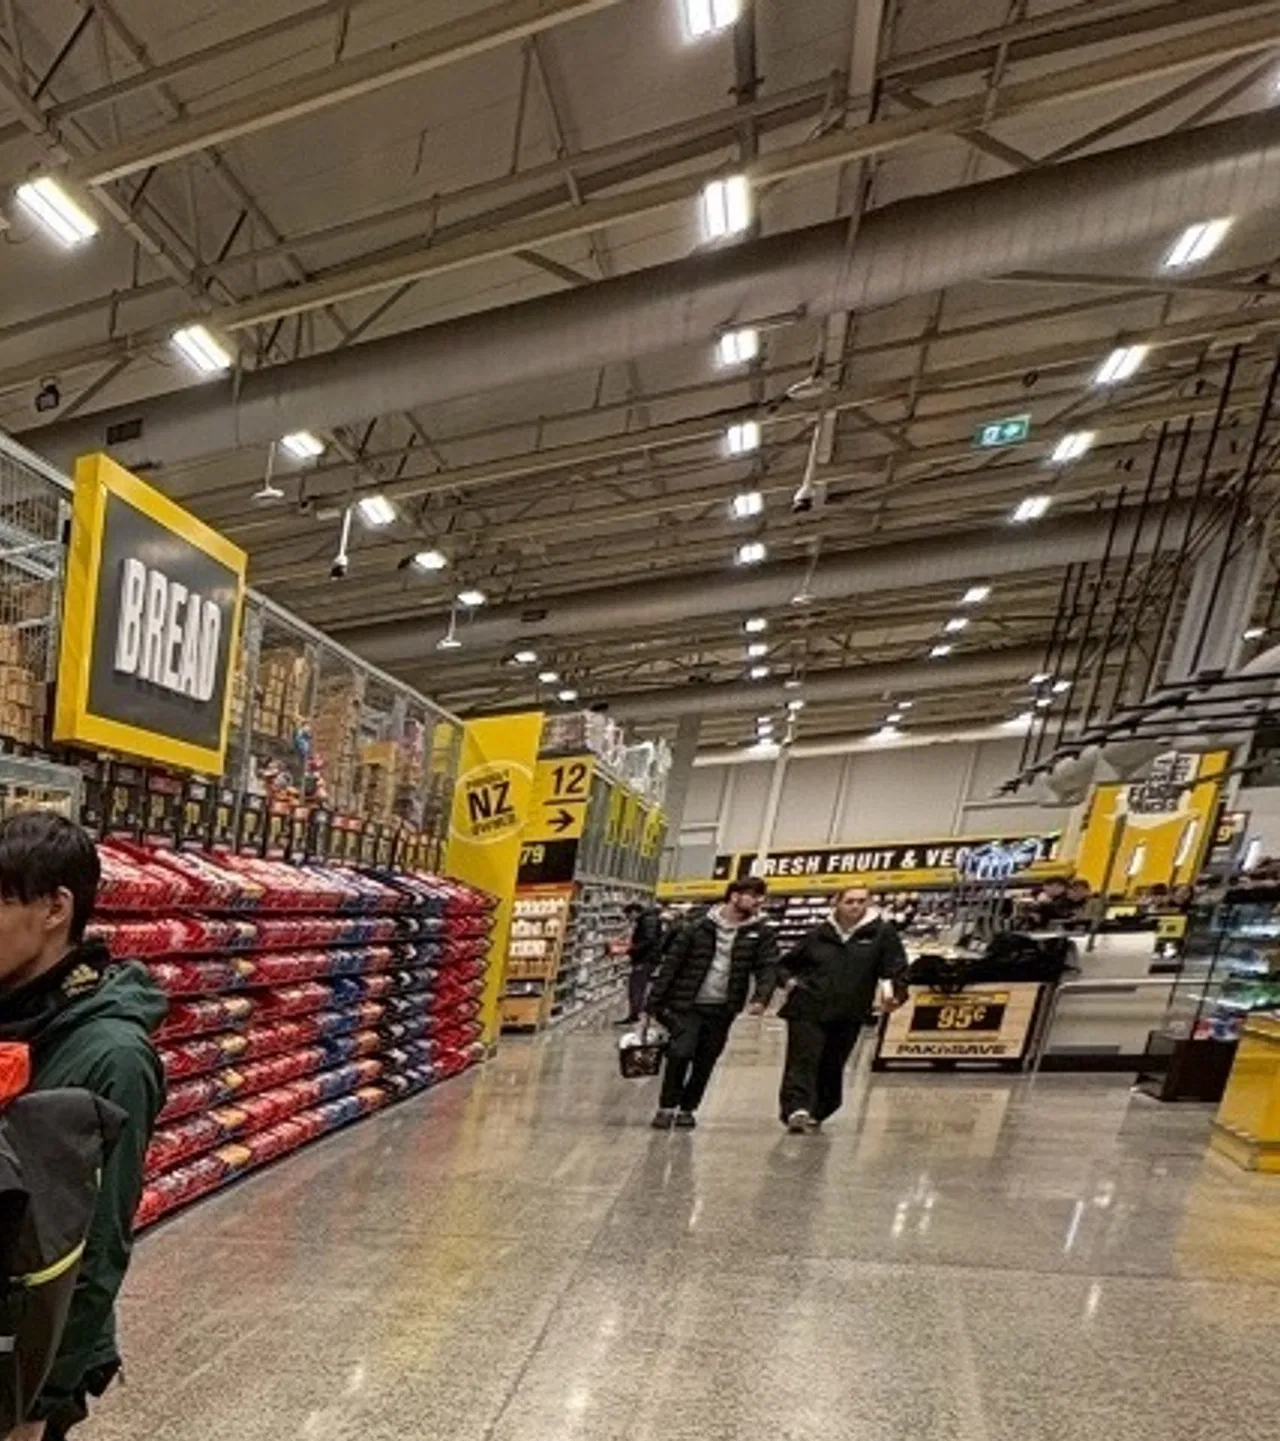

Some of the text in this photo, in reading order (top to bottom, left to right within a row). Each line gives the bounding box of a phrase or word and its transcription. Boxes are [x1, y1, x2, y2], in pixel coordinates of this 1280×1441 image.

[114, 558, 221, 701] BREAD
[551, 763, 586, 797] 12
[467, 780, 515, 823] NZ
[826, 851, 896, 872] FRUIT
[900, 849, 918, 870] &
